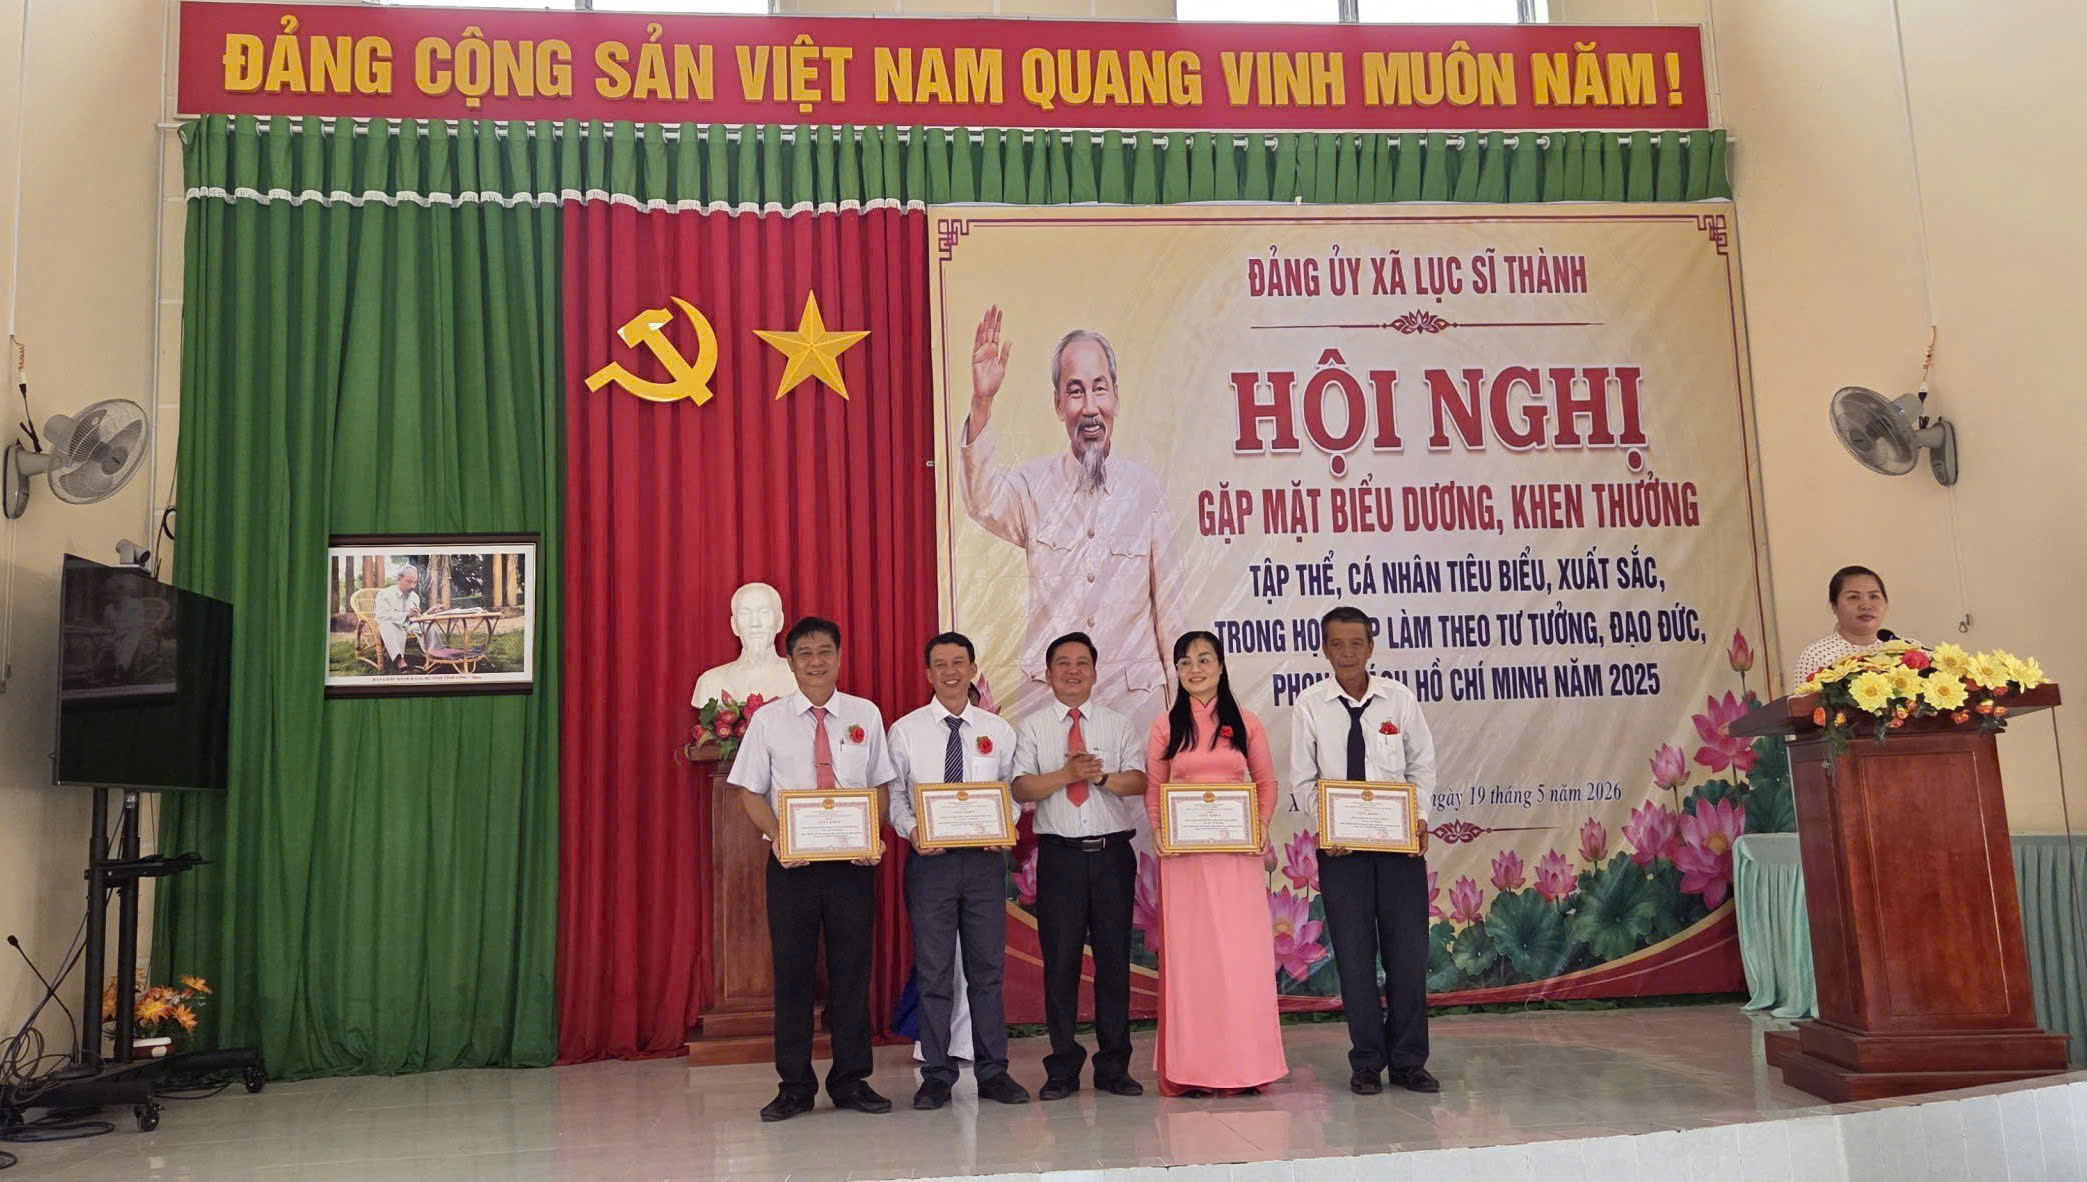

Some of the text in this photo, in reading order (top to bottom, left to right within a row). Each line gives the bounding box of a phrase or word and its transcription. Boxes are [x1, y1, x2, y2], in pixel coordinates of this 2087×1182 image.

[222, 15, 392, 95] ĐẢNG
[414, 26, 573, 108] CỘNG
[595, 24, 714, 100] SẢN
[735, 34, 852, 113] VIỆT
[874, 47, 1003, 104] NAM
[1022, 49, 1202, 111] QUANG
[1221, 51, 1345, 106] VINH
[1361, 41, 1518, 106] MUÔN
[1249, 244, 1587, 303] ĐẢNG ỦY XÃ LỤC SĨ THÀNH
[1229, 348, 1649, 478] HỘI NGHỊ
[1199, 471, 1700, 544] GẶP MẶT BIỂU DƯƠNG, KHEN THƯỞNG
[1250, 544, 1665, 604] TẬP THỂ, CÁ NHÂN TIÊU BIỂU, XUẤT SẮC,
[1215, 618, 1285, 653] TRONG
[1293, 618, 1321, 657] HỌ
[1388, 609, 1433, 649] LÀM
[1438, 614, 1491, 648] THEO
[1496, 610, 1523, 646] TƯ
[1528, 601, 1604, 648] TƯỞNG,
[1610, 610, 1651, 648] ĐẠO
[1658, 603, 1706, 644] ĐỨC,
[1415, 657, 1443, 702] HỒ
[1449, 660, 1486, 701] CHÍ
[1491, 666, 1549, 700] MINH
[1554, 658, 1603, 698] NĂM
[1609, 663, 1660, 696] 2025
[1470, 786, 1486, 804] 19
[1491, 785, 1532, 808] tháng
[1537, 784, 1545, 802] 5
[1550, 785, 1581, 802] năm
[1587, 782, 1621, 801] 2026
